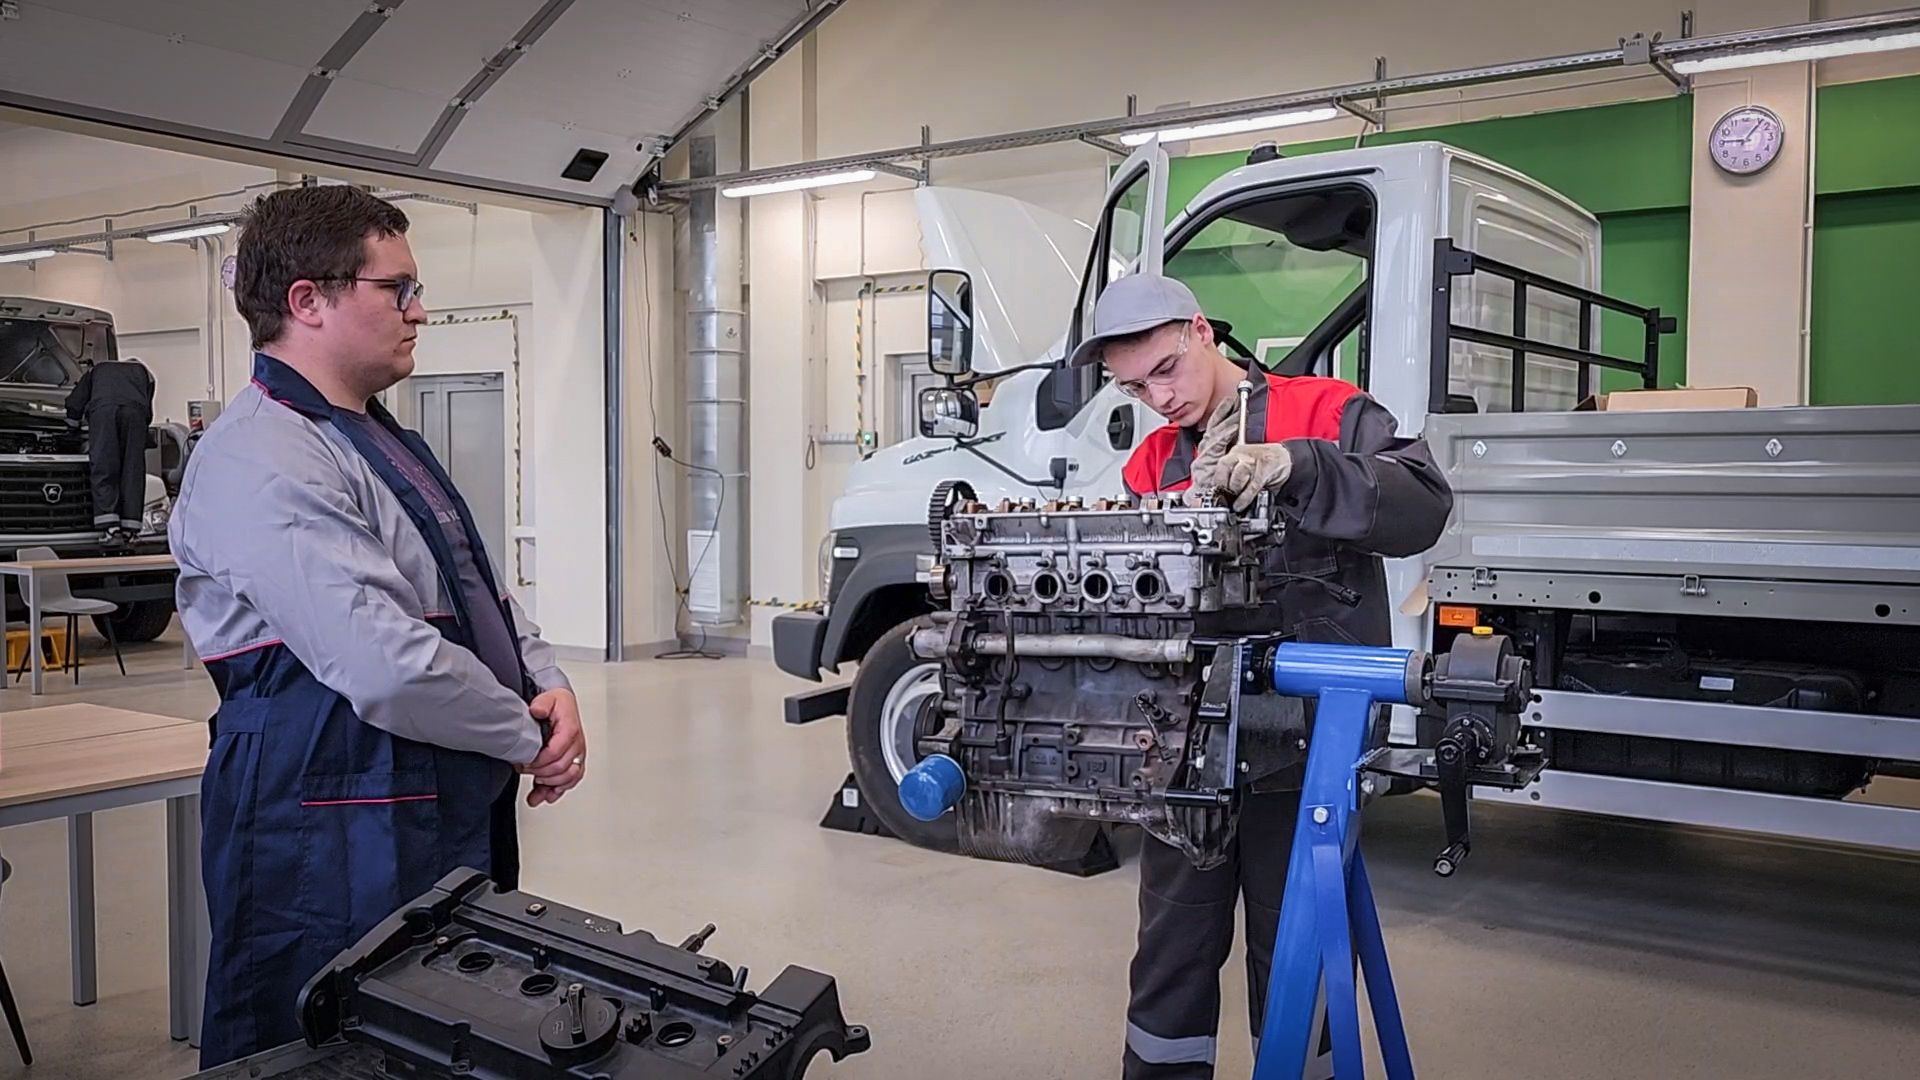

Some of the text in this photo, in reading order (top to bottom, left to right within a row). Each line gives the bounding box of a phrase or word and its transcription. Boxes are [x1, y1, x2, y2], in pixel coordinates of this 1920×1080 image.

[1730, 119, 1738, 127] 11
[1763, 121, 1771, 131] 2
[1721, 127, 1731, 137] 10
[1767, 132, 1774, 141] 3
[1763, 144, 1770, 152] 4
[1722, 150, 1729, 158] 8
[1755, 153, 1762, 162] 5
[1730, 156, 1738, 165] 7
[1743, 158, 1750, 167] 6
